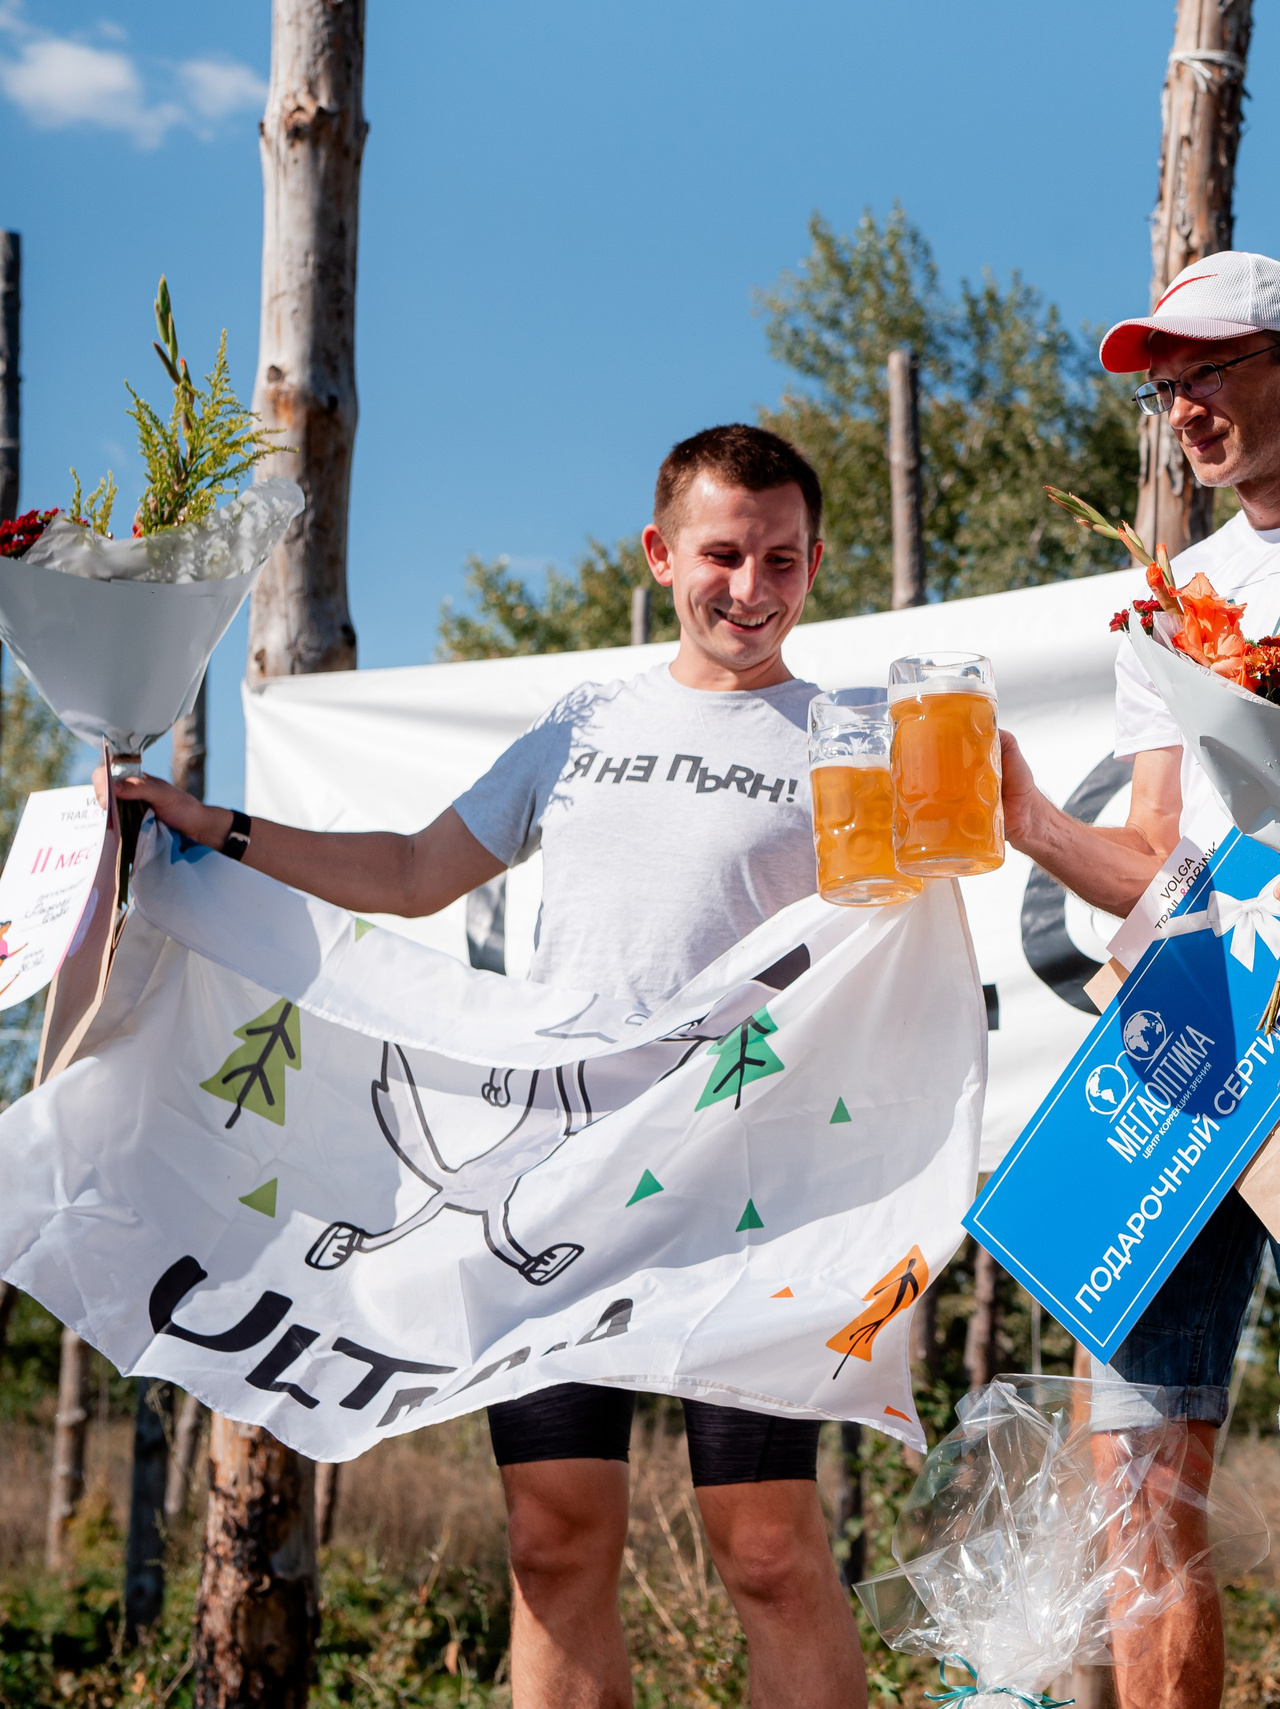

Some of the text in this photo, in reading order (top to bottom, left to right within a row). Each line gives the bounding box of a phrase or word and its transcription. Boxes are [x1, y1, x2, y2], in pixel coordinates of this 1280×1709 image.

[566, 751, 598, 778] Я
[1160, 857, 1195, 899] VOLGA
[1106, 1025, 1216, 1164] МЕГАОПТИКА
[1142, 1061, 1213, 1159] ЦЕНТР КОРРЕКЦИИ ЗРЕНИЯ
[1074, 1113, 1220, 1314] ПОДАРОЧНЫЙ
